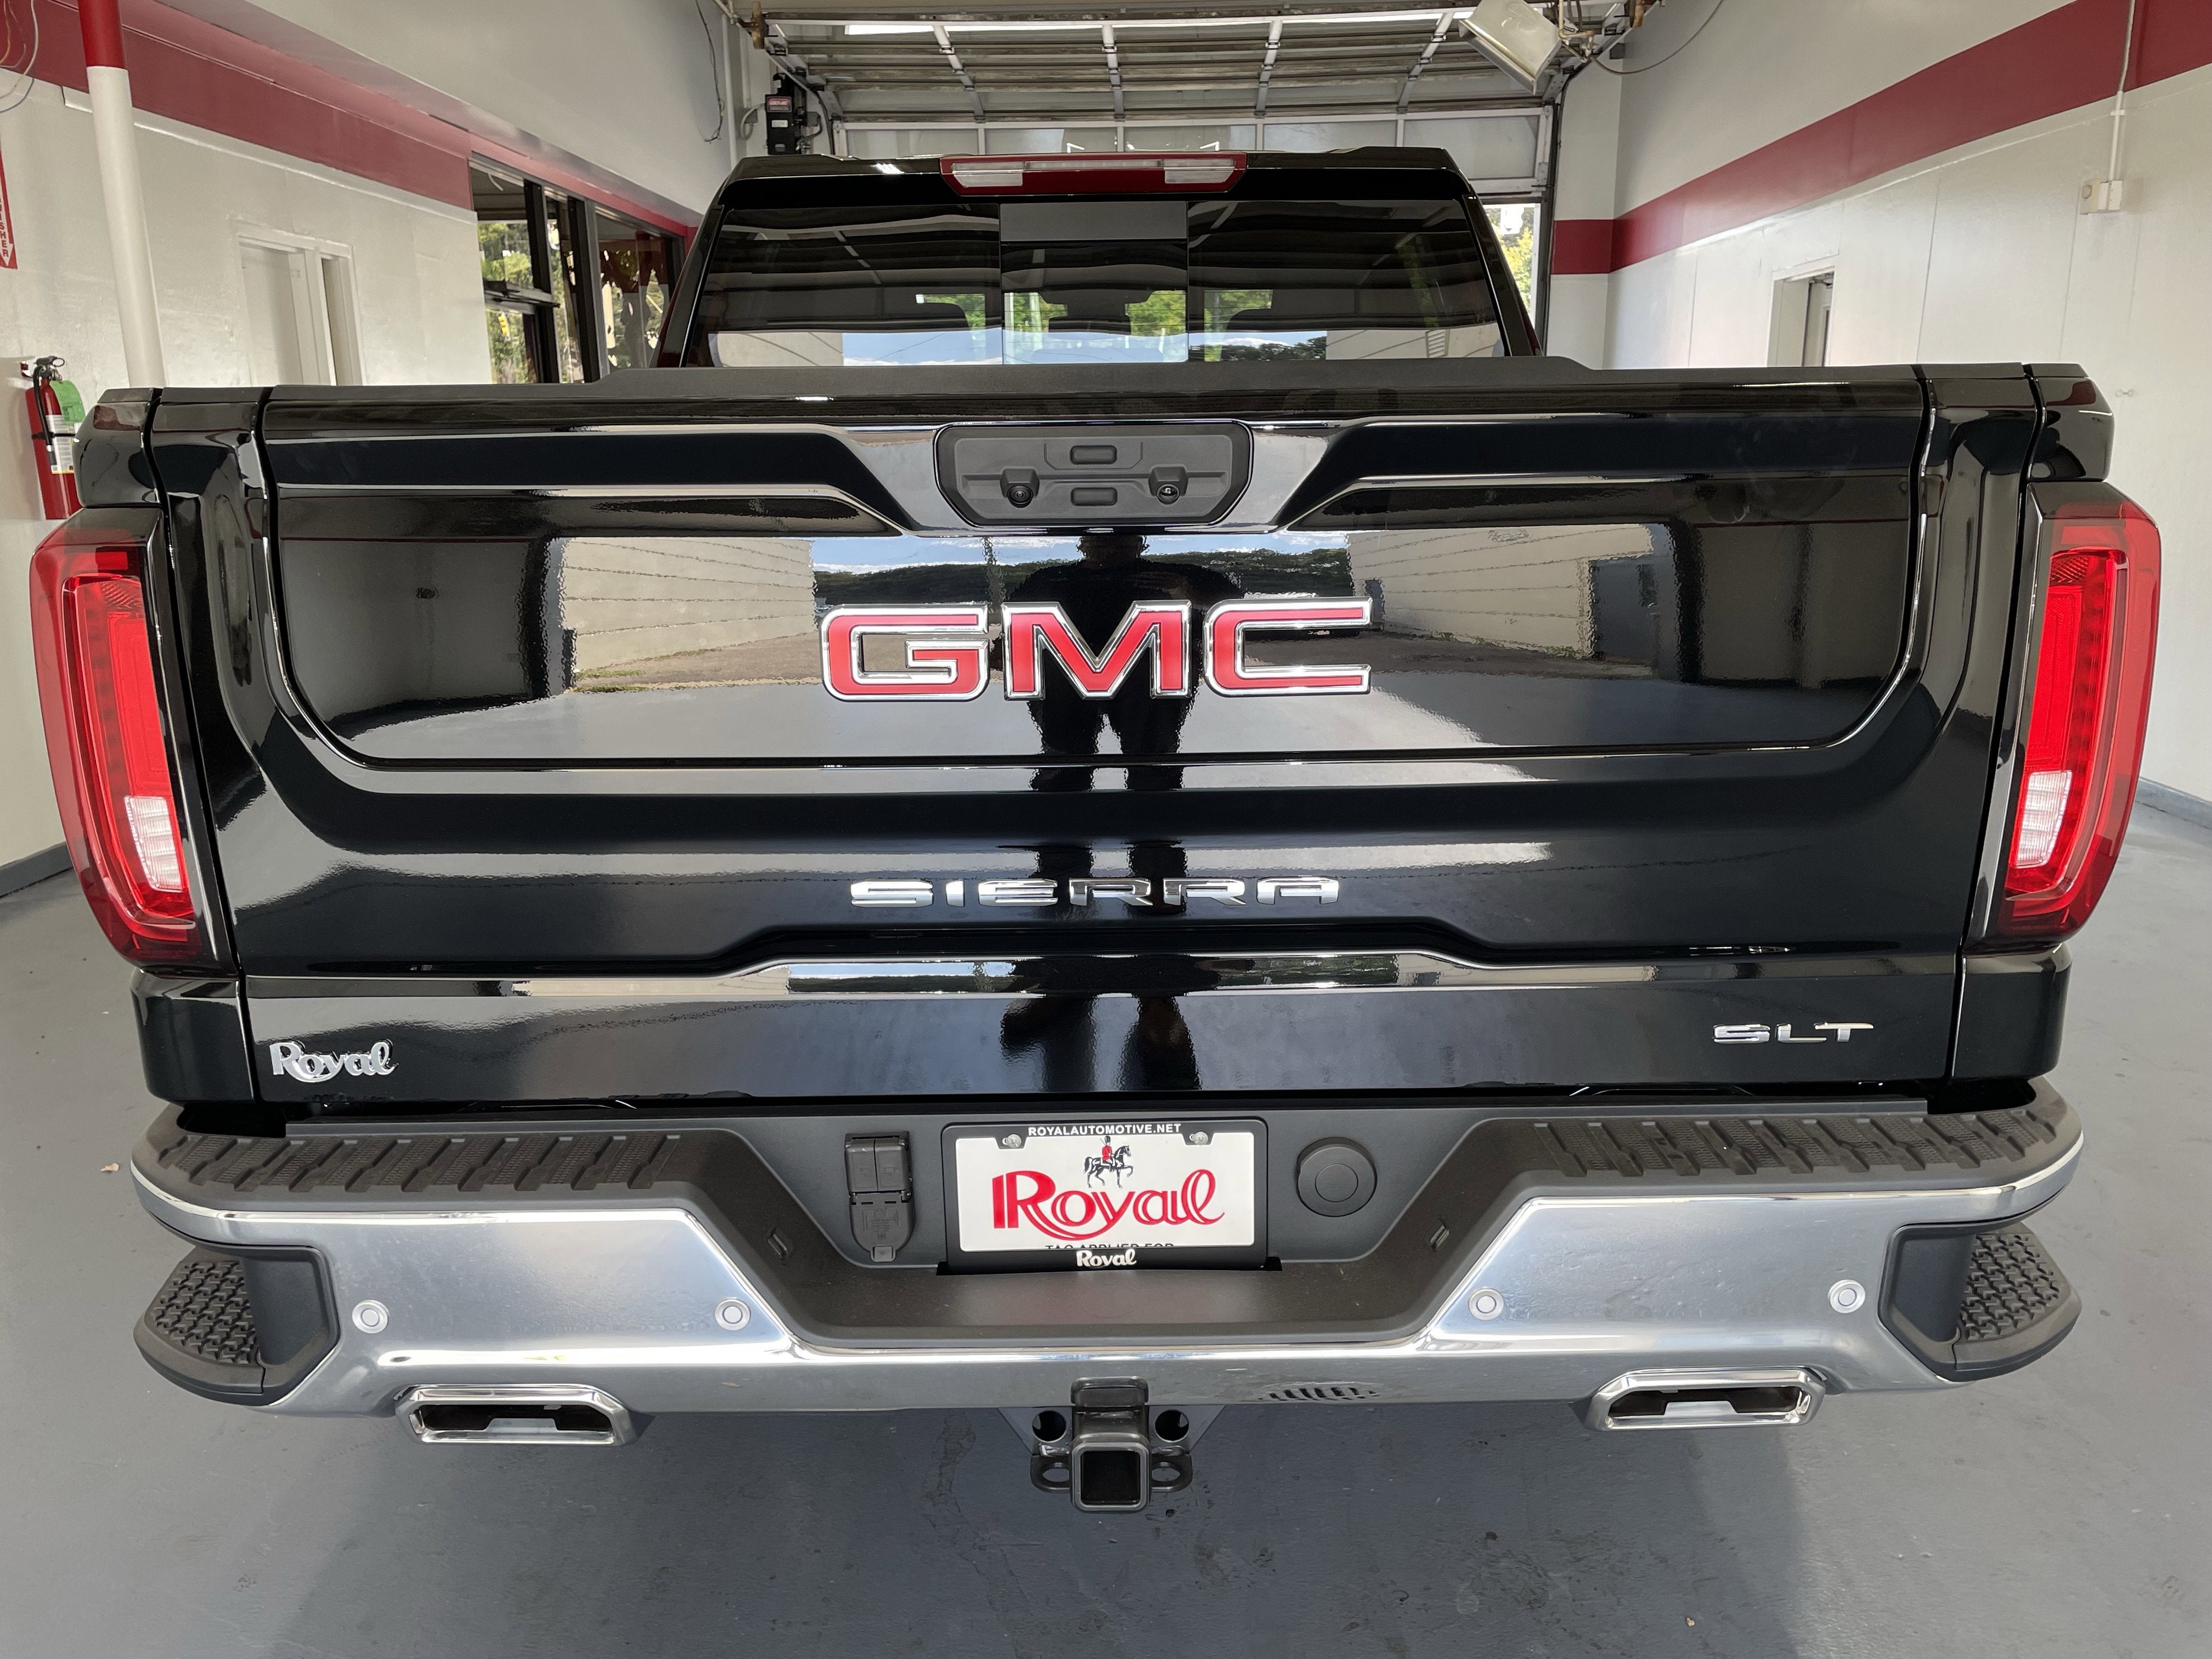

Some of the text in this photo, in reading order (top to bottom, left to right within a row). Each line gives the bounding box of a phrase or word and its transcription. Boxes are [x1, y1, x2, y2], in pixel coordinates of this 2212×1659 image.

[821, 596, 1372, 702] GMC
[850, 876, 1340, 907] SIERRA
[1713, 1022, 1874, 1043] SLT
[269, 1039, 399, 1083] Royal
[1028, 1123, 1182, 1136] ROYALAUTOMOTIVE.NET
[992, 1169, 1225, 1241] Royal
[1076, 1248, 1137, 1268] Royal
